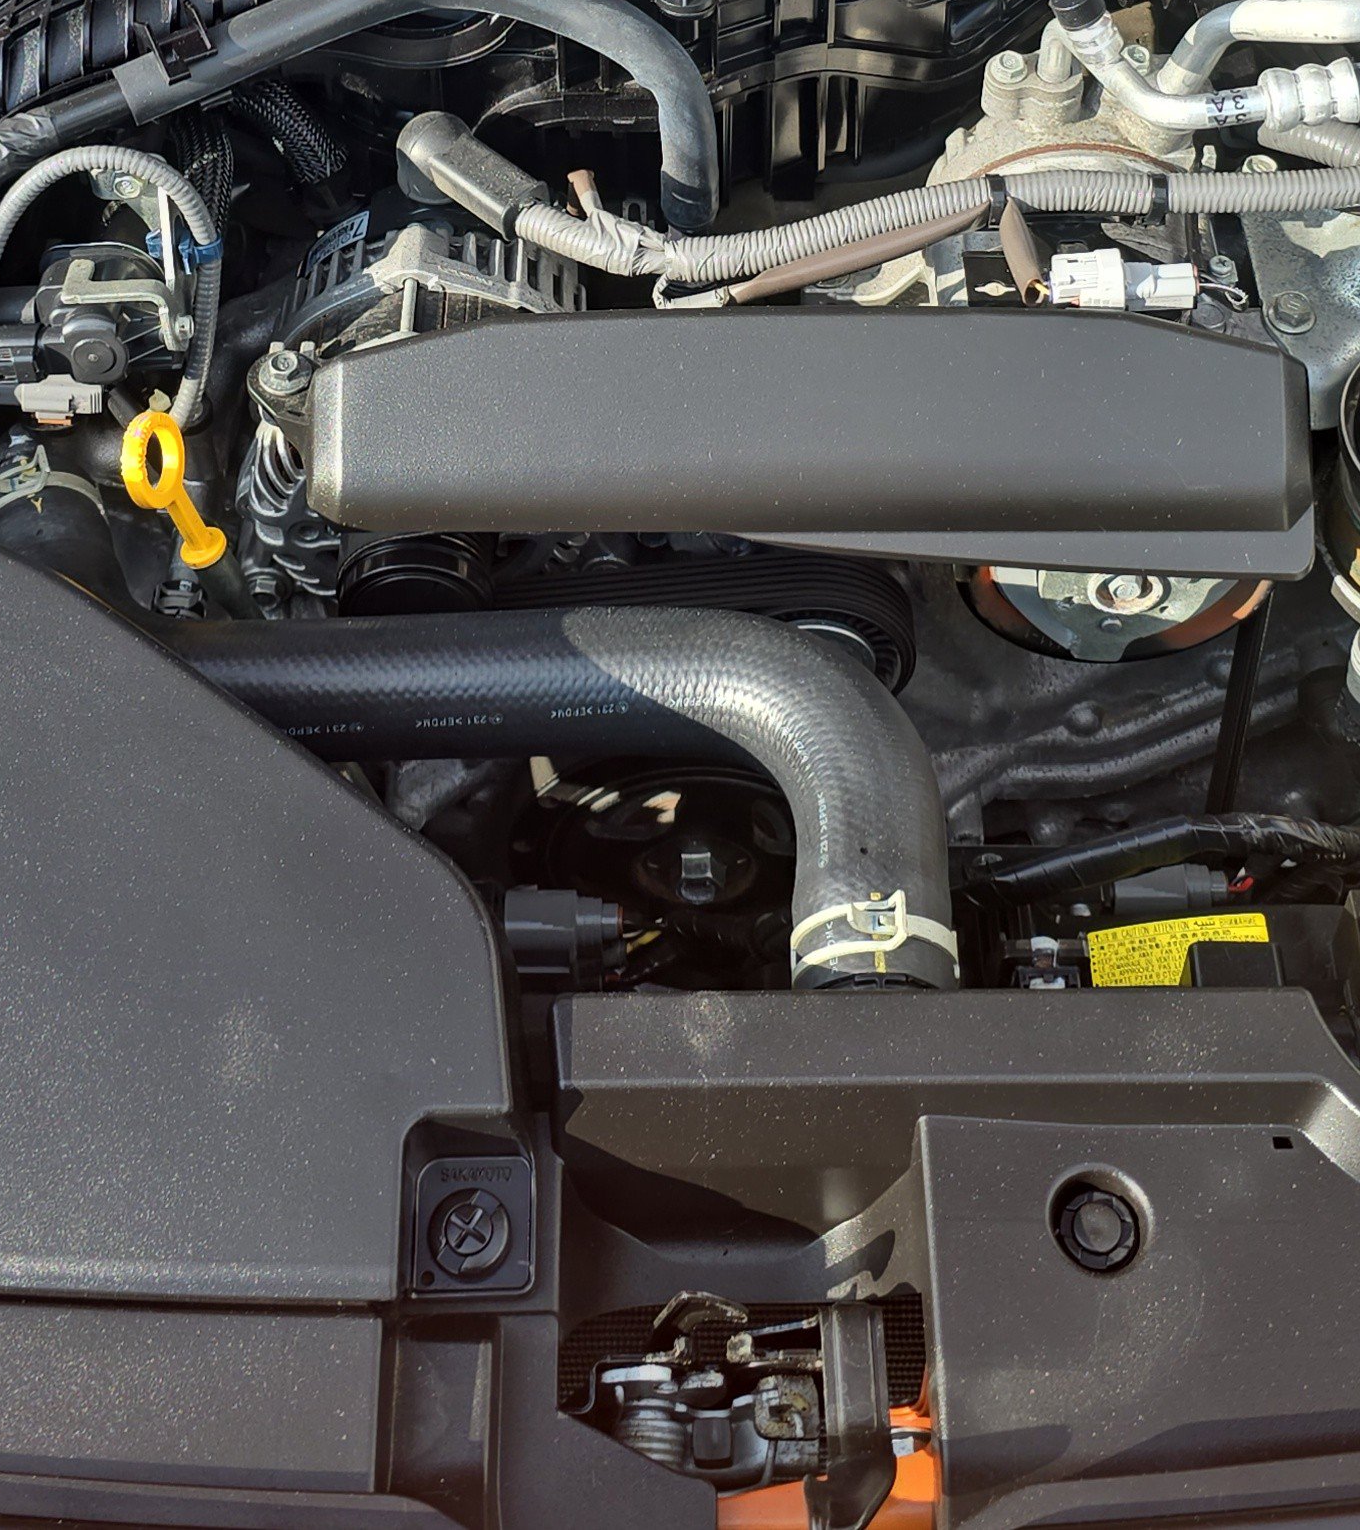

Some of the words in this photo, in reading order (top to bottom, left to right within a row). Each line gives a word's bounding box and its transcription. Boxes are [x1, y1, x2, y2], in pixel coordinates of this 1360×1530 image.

[467, 715, 487, 725] 231
[326, 723, 347, 734] 231
[1120, 926, 1149, 938] CAUTION
[1153, 922, 1189, 934] ATTENTION
